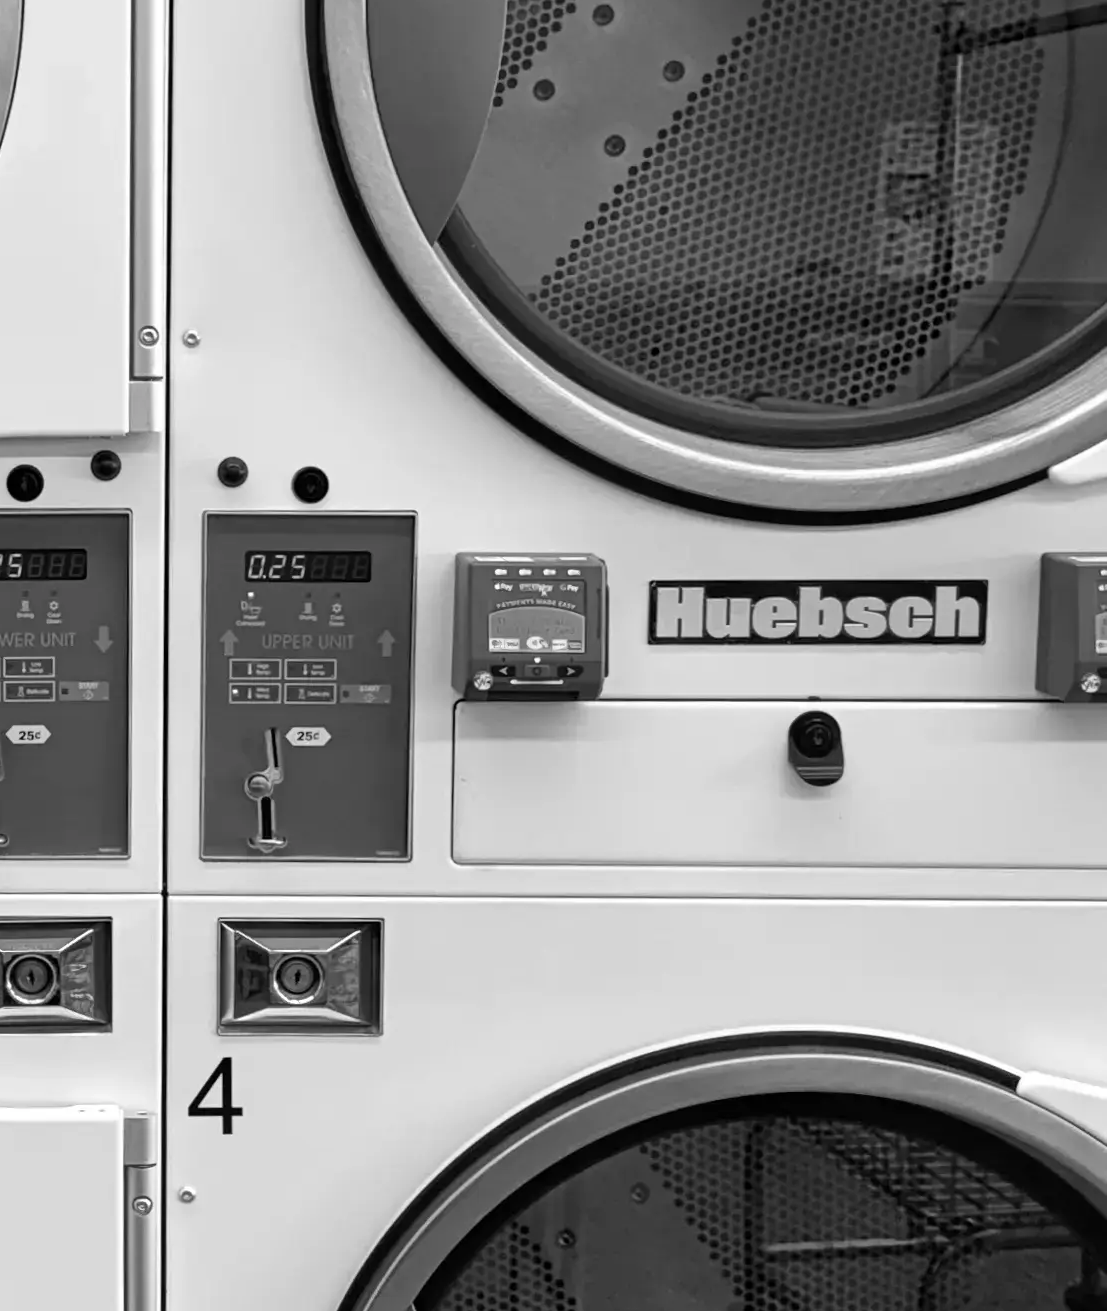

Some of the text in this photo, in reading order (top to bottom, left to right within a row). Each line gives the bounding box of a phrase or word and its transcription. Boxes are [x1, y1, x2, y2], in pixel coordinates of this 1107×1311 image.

[247, 554, 306, 579] 0.25
[656, 586, 981, 639] Huebsch
[40, 632, 77, 648] UNIT
[262, 634, 355, 650] UPPER UNIT
[188, 1057, 243, 1135] 4
